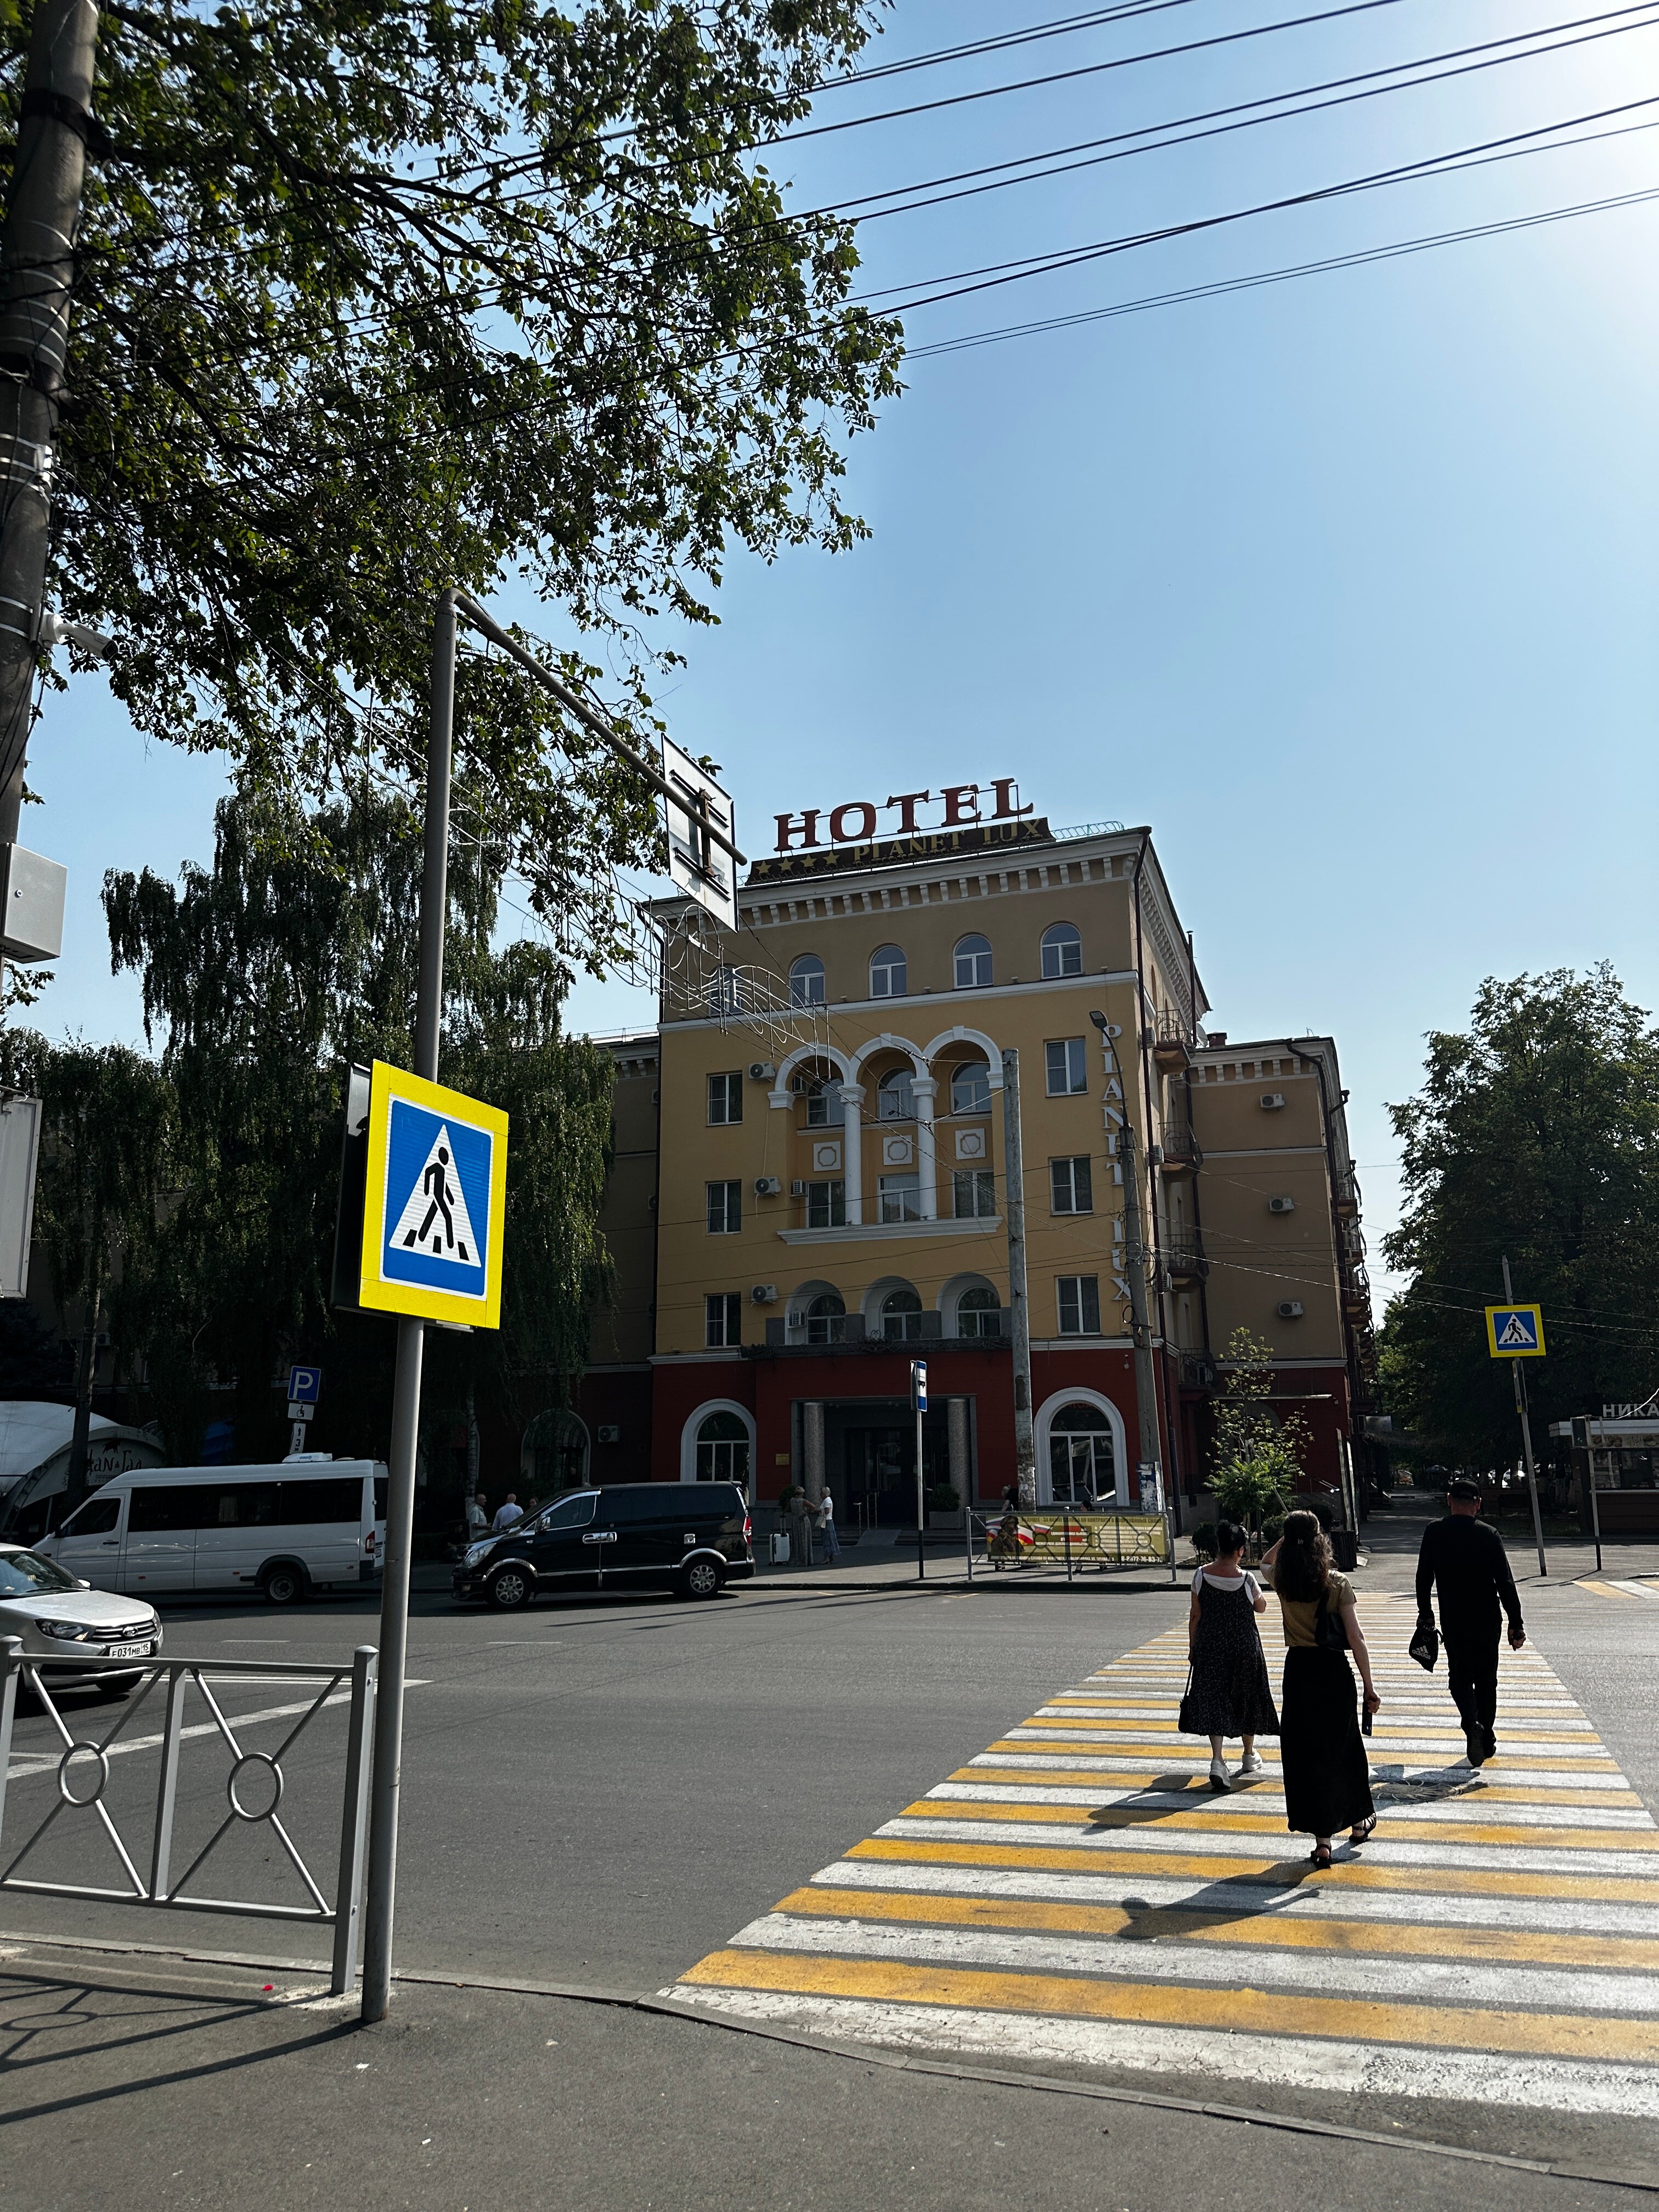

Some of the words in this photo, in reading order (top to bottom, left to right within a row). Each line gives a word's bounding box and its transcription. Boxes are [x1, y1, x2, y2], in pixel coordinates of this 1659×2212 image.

[773, 778, 1034, 852] HOTEL
[853, 830, 965, 865] PLANET
[983, 819, 1043, 845] LUX
[293, 1372, 313, 1399] P
[1602, 1403, 1659, 1418] НИКА
[295, 1438, 301, 1447] 3
